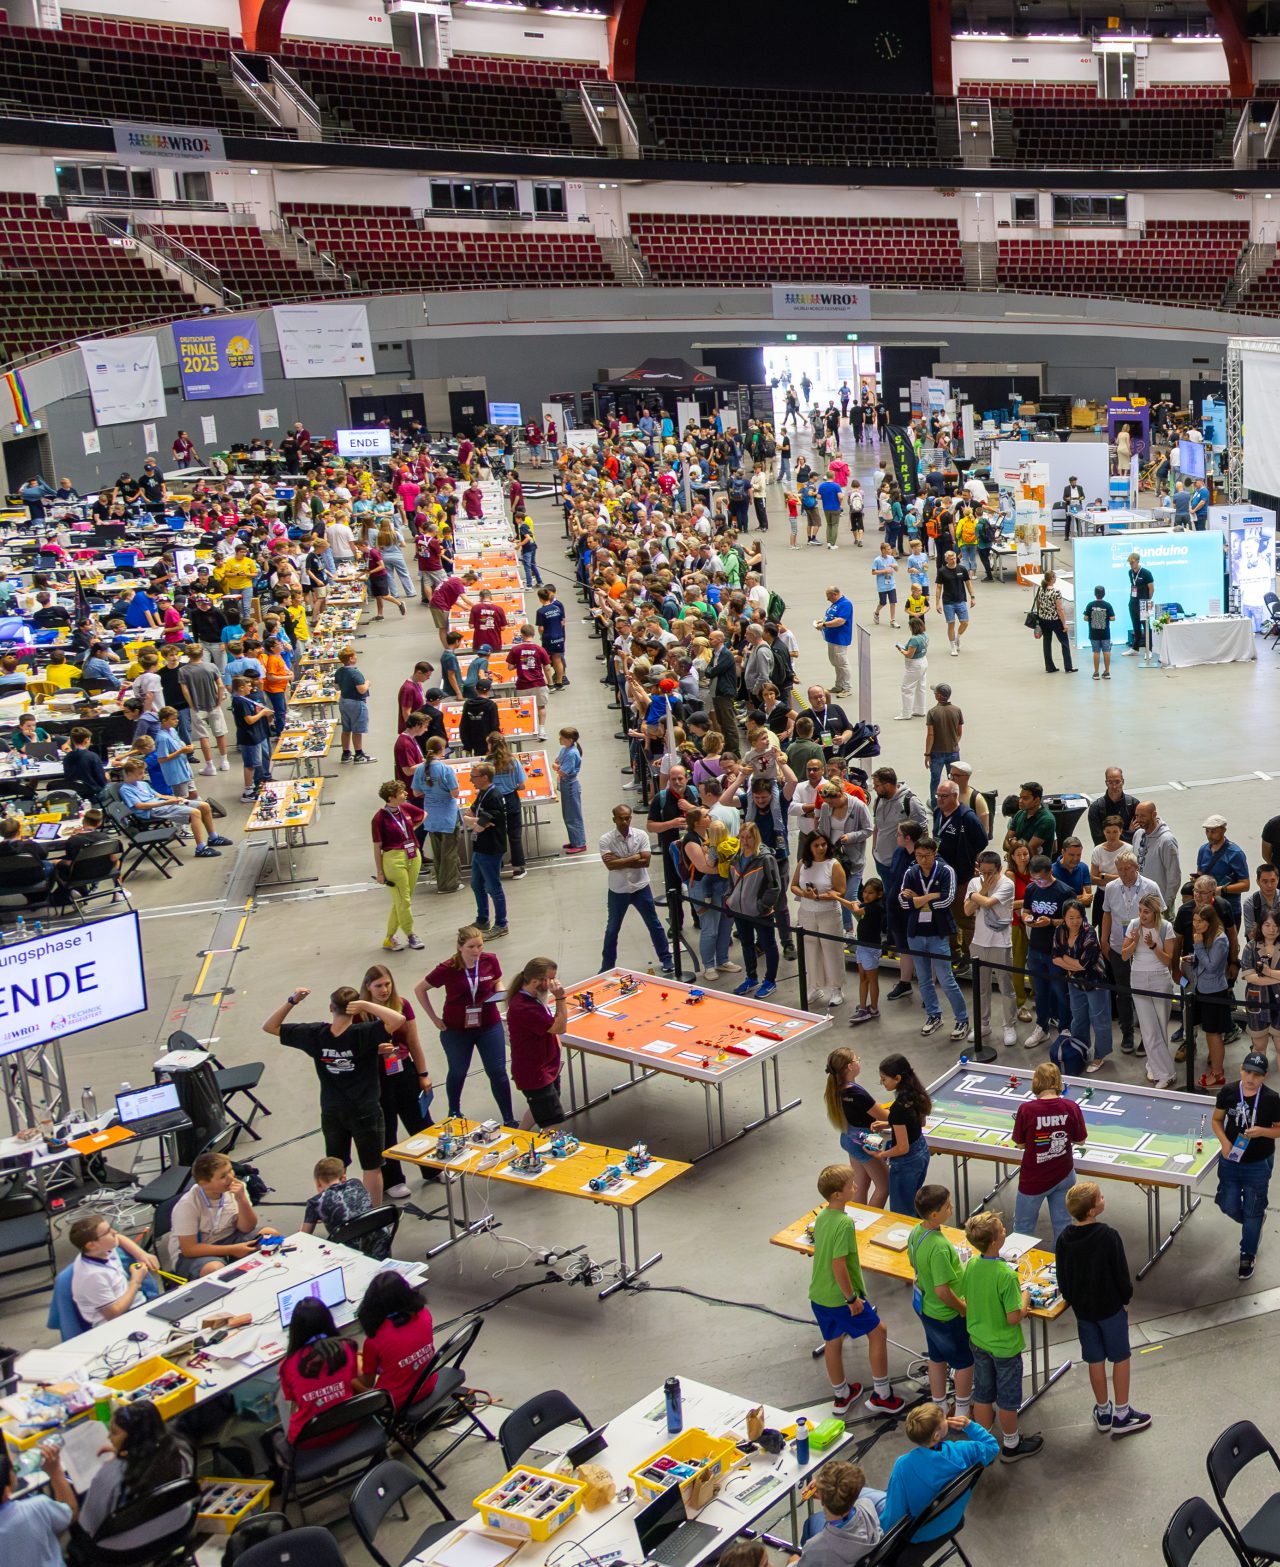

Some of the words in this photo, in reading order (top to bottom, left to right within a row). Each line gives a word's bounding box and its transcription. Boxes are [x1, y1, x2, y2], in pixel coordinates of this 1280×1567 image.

[368, 15, 382, 23] 418
[168, 136, 204, 152] WRO
[820, 293, 852, 305] WRO
[180, 335, 216, 343] DEUTSCHLAND
[180, 343, 217, 356] FINALE
[183, 355, 220, 373] 2025
[350, 438, 379, 448] ENDE
[895, 435, 912, 492] SHIRTS
[1133, 544, 1189, 557] Funduino
[0, 936, 82, 967] ungsphase
[86, 931, 93, 942] 1
[67, 1005, 102, 1019] TECHNIK
[12, 1025, 35, 1038] WRO
[1036, 1114, 1068, 1130] JURY
